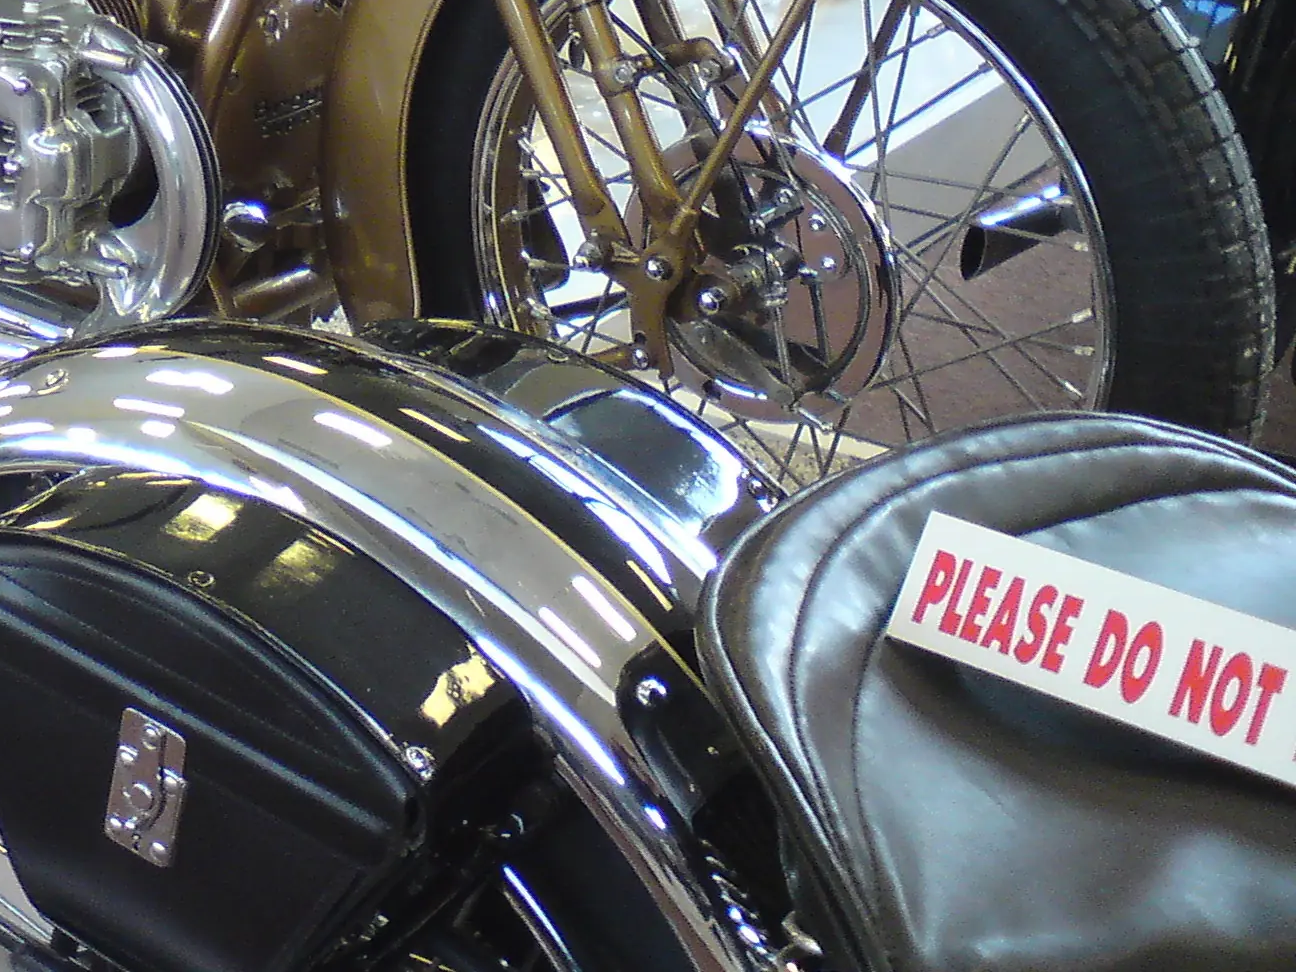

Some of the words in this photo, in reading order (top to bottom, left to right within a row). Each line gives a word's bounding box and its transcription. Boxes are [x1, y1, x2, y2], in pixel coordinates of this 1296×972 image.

[911, 549, 1085, 674] PLEASE
[1083, 608, 1164, 705] DO
[1168, 638, 1288, 747] NOT
